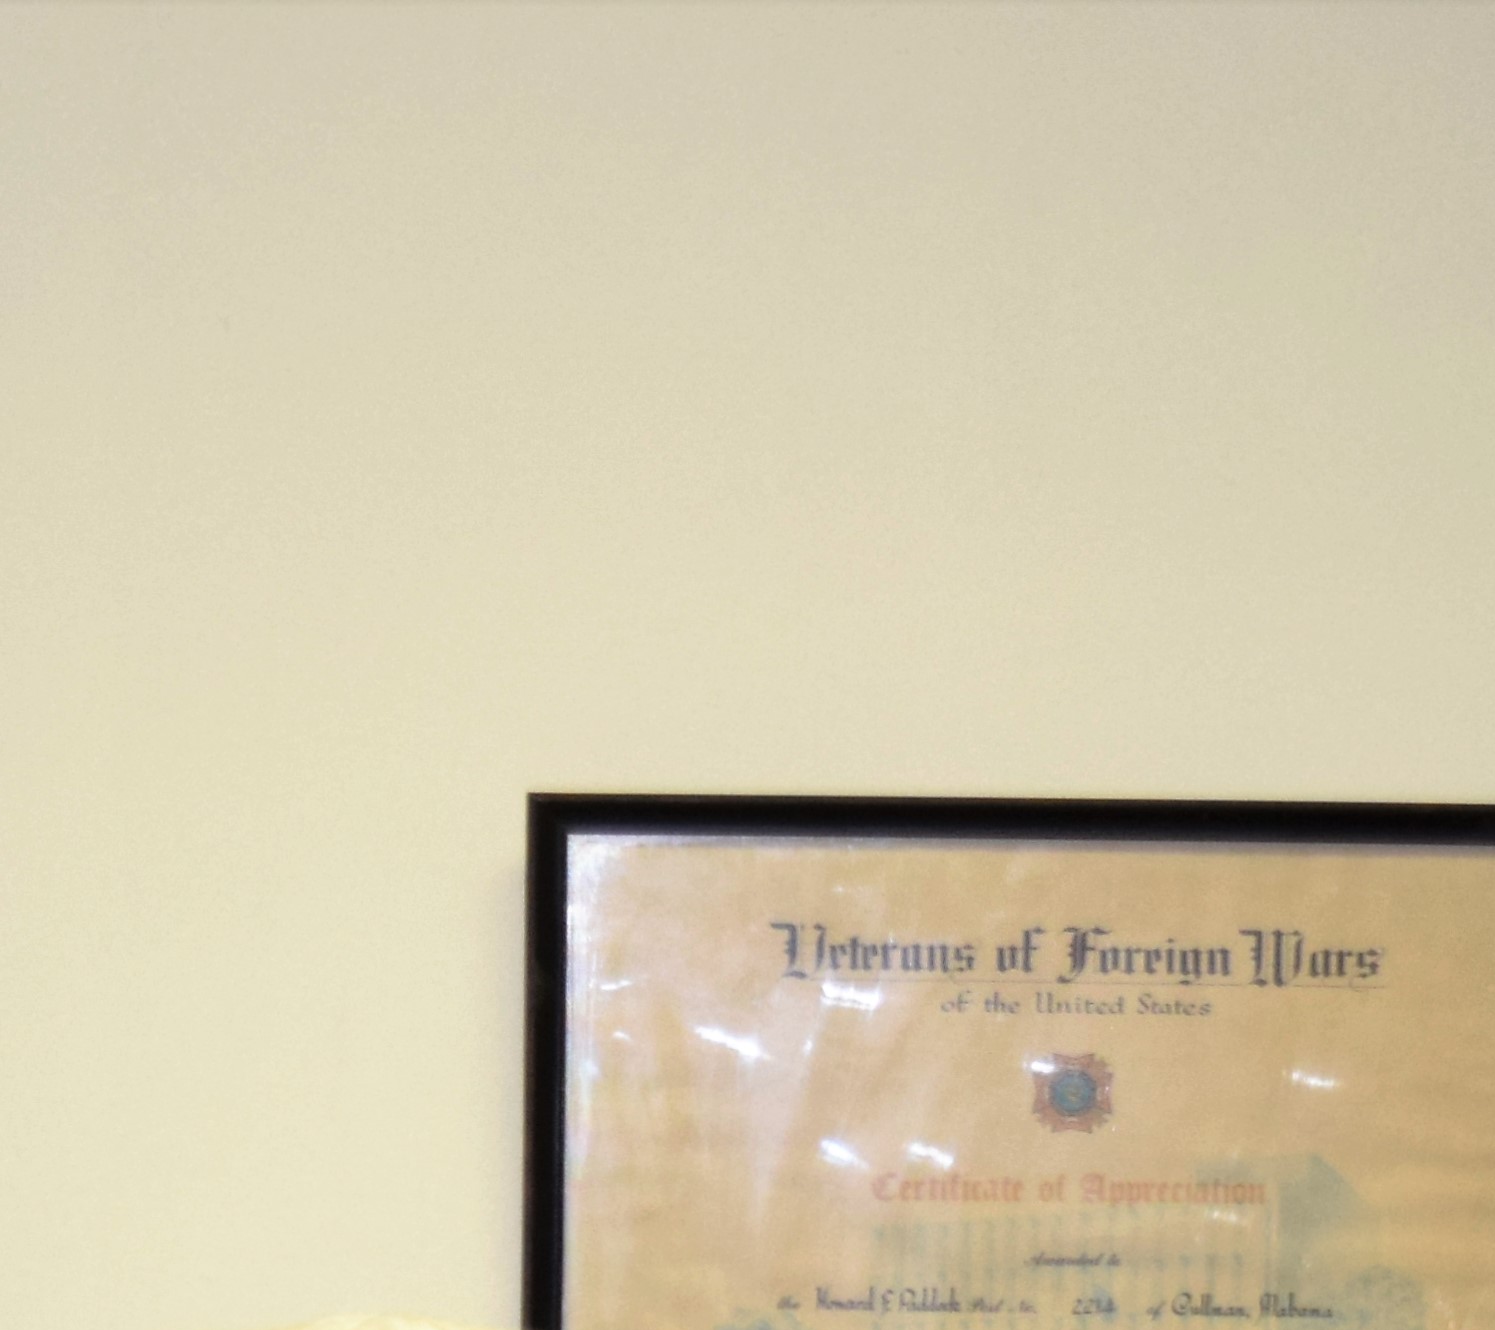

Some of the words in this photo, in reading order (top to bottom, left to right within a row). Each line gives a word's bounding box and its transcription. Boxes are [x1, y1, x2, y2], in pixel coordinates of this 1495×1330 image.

[770, 921, 975, 980] Veterans
[995, 926, 1046, 974] of
[1057, 927, 1232, 985] Foreign
[1239, 928, 1382, 988] Wars
[940, 991, 970, 1015] of
[984, 991, 1021, 1015] the
[1036, 991, 1125, 1016] United
[1137, 992, 1213, 1016] States
[869, 1171, 1024, 1204] Certificate
[1038, 1173, 1066, 1202] of
[1080, 1172, 1267, 1206] Appreciation
[815, 1286, 874, 1311] Howard
[899, 1287, 961, 1312] Paddock
[1171, 1292, 1251, 1318] Cullman,
[1259, 1291, 1334, 1319] Alabama
